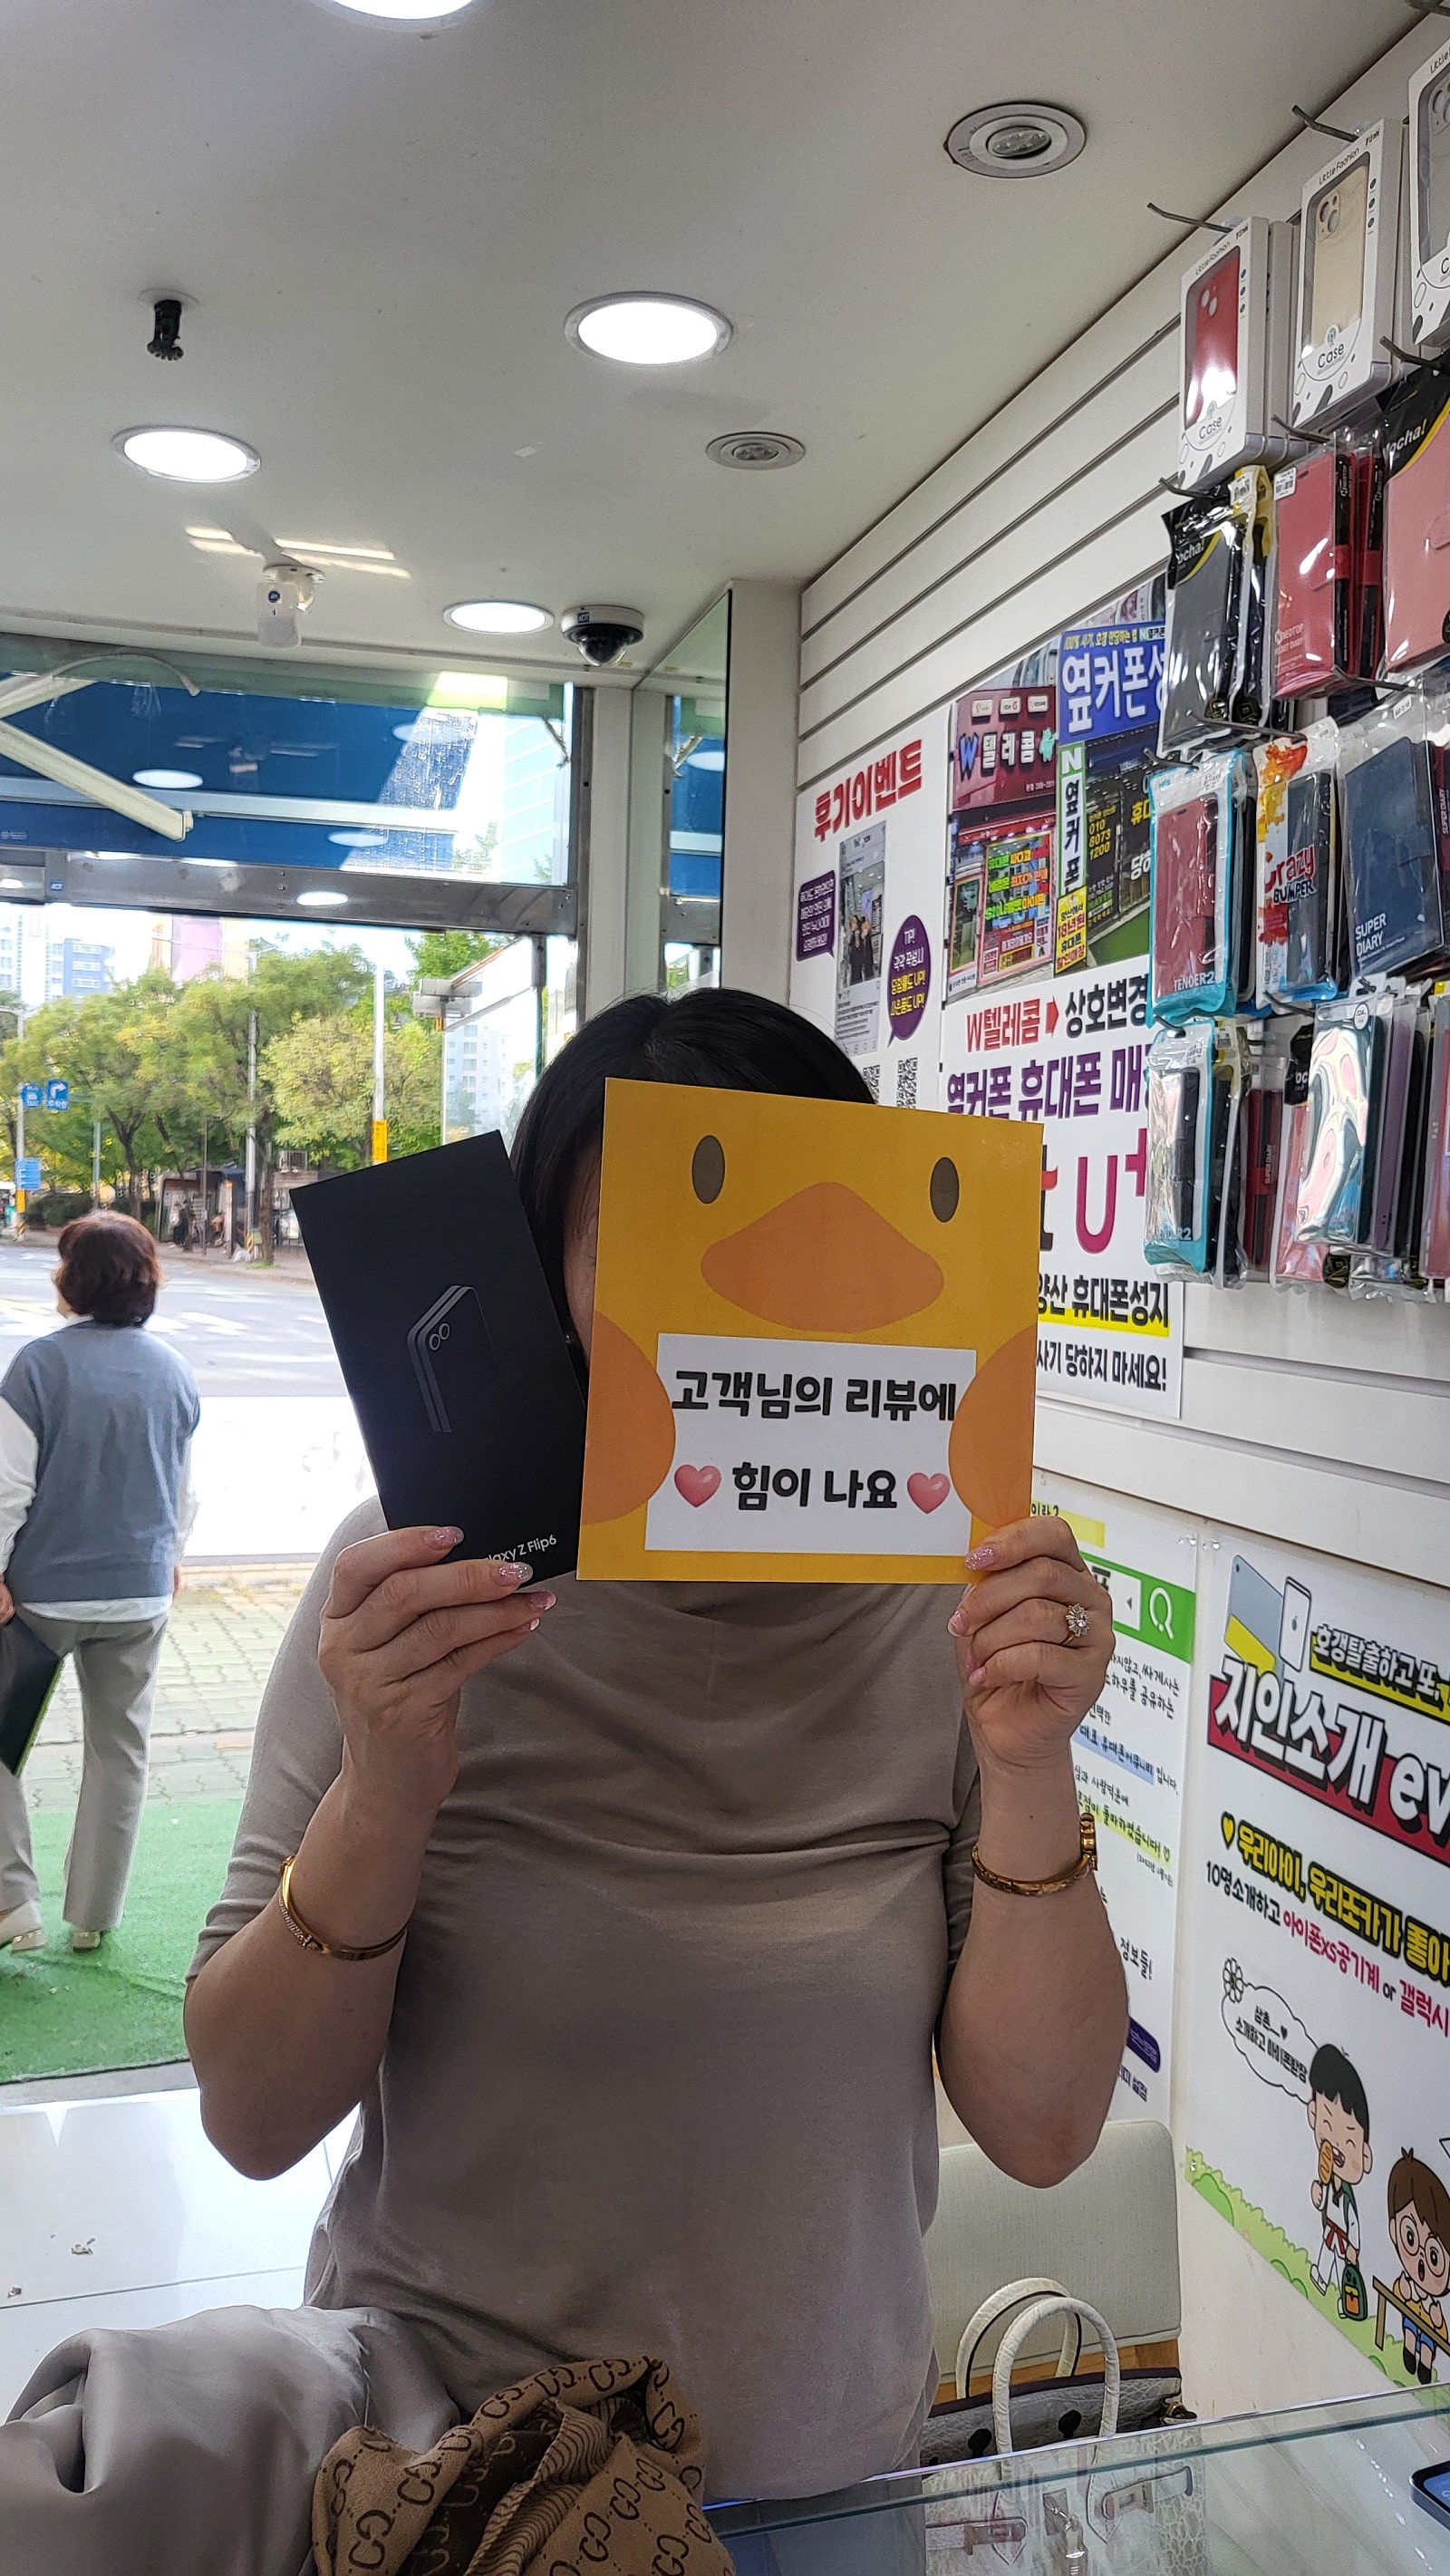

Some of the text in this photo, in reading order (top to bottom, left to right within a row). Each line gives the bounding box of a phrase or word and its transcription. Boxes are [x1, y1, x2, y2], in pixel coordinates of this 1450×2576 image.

[1317, 343, 1345, 368] Case
[1198, 416, 1223, 439] Case
[1061, 747, 1082, 775] N
[815, 739, 923, 843] 후기이벤트
[1088, 828, 1111, 847] 8073
[1089, 819, 1106, 835] 010
[1089, 841, 1110, 860] 1200
[1273, 878, 1317, 904] BUMPER
[1355, 913, 1387, 940] SUPER
[1356, 930, 1384, 957] DIARY
[1173, 972, 1215, 993] TENDER2
[966, 974, 1148, 1052] W텔레콤 상호변경
[1018, 1051, 1101, 1122] 휴대폰
[1109, 1043, 1149, 1114] 매
[1072, 1274, 1169, 1328] 휴대폰성지
[1036, 1340, 1166, 1392] 사기 당하지 마세요!
[672, 1370, 957, 1422] 고객님의 리뷰에
[732, 1461, 898, 1511] 힘이 나요
[517, 1544, 527, 1556] Z
[527, 1535, 557, 1553] Flip6
[1313, 1622, 1440, 1701] 호갱탈출하고 또,
[1139, 1684, 1174, 1719] 공유하는
[1078, 1723, 1098, 1746] 대표
[1100, 1736, 1155, 1777] 휴대폰커뮤니티
[1213, 1656, 1386, 1806] 지인소개
[1238, 1822, 1306, 1898] 우리아이,
[1309, 1866, 1402, 1954] 우리조카가
[1206, 1861, 1450, 2039] 10명소개하고 아이폰XS공기계 or 갤럭시
